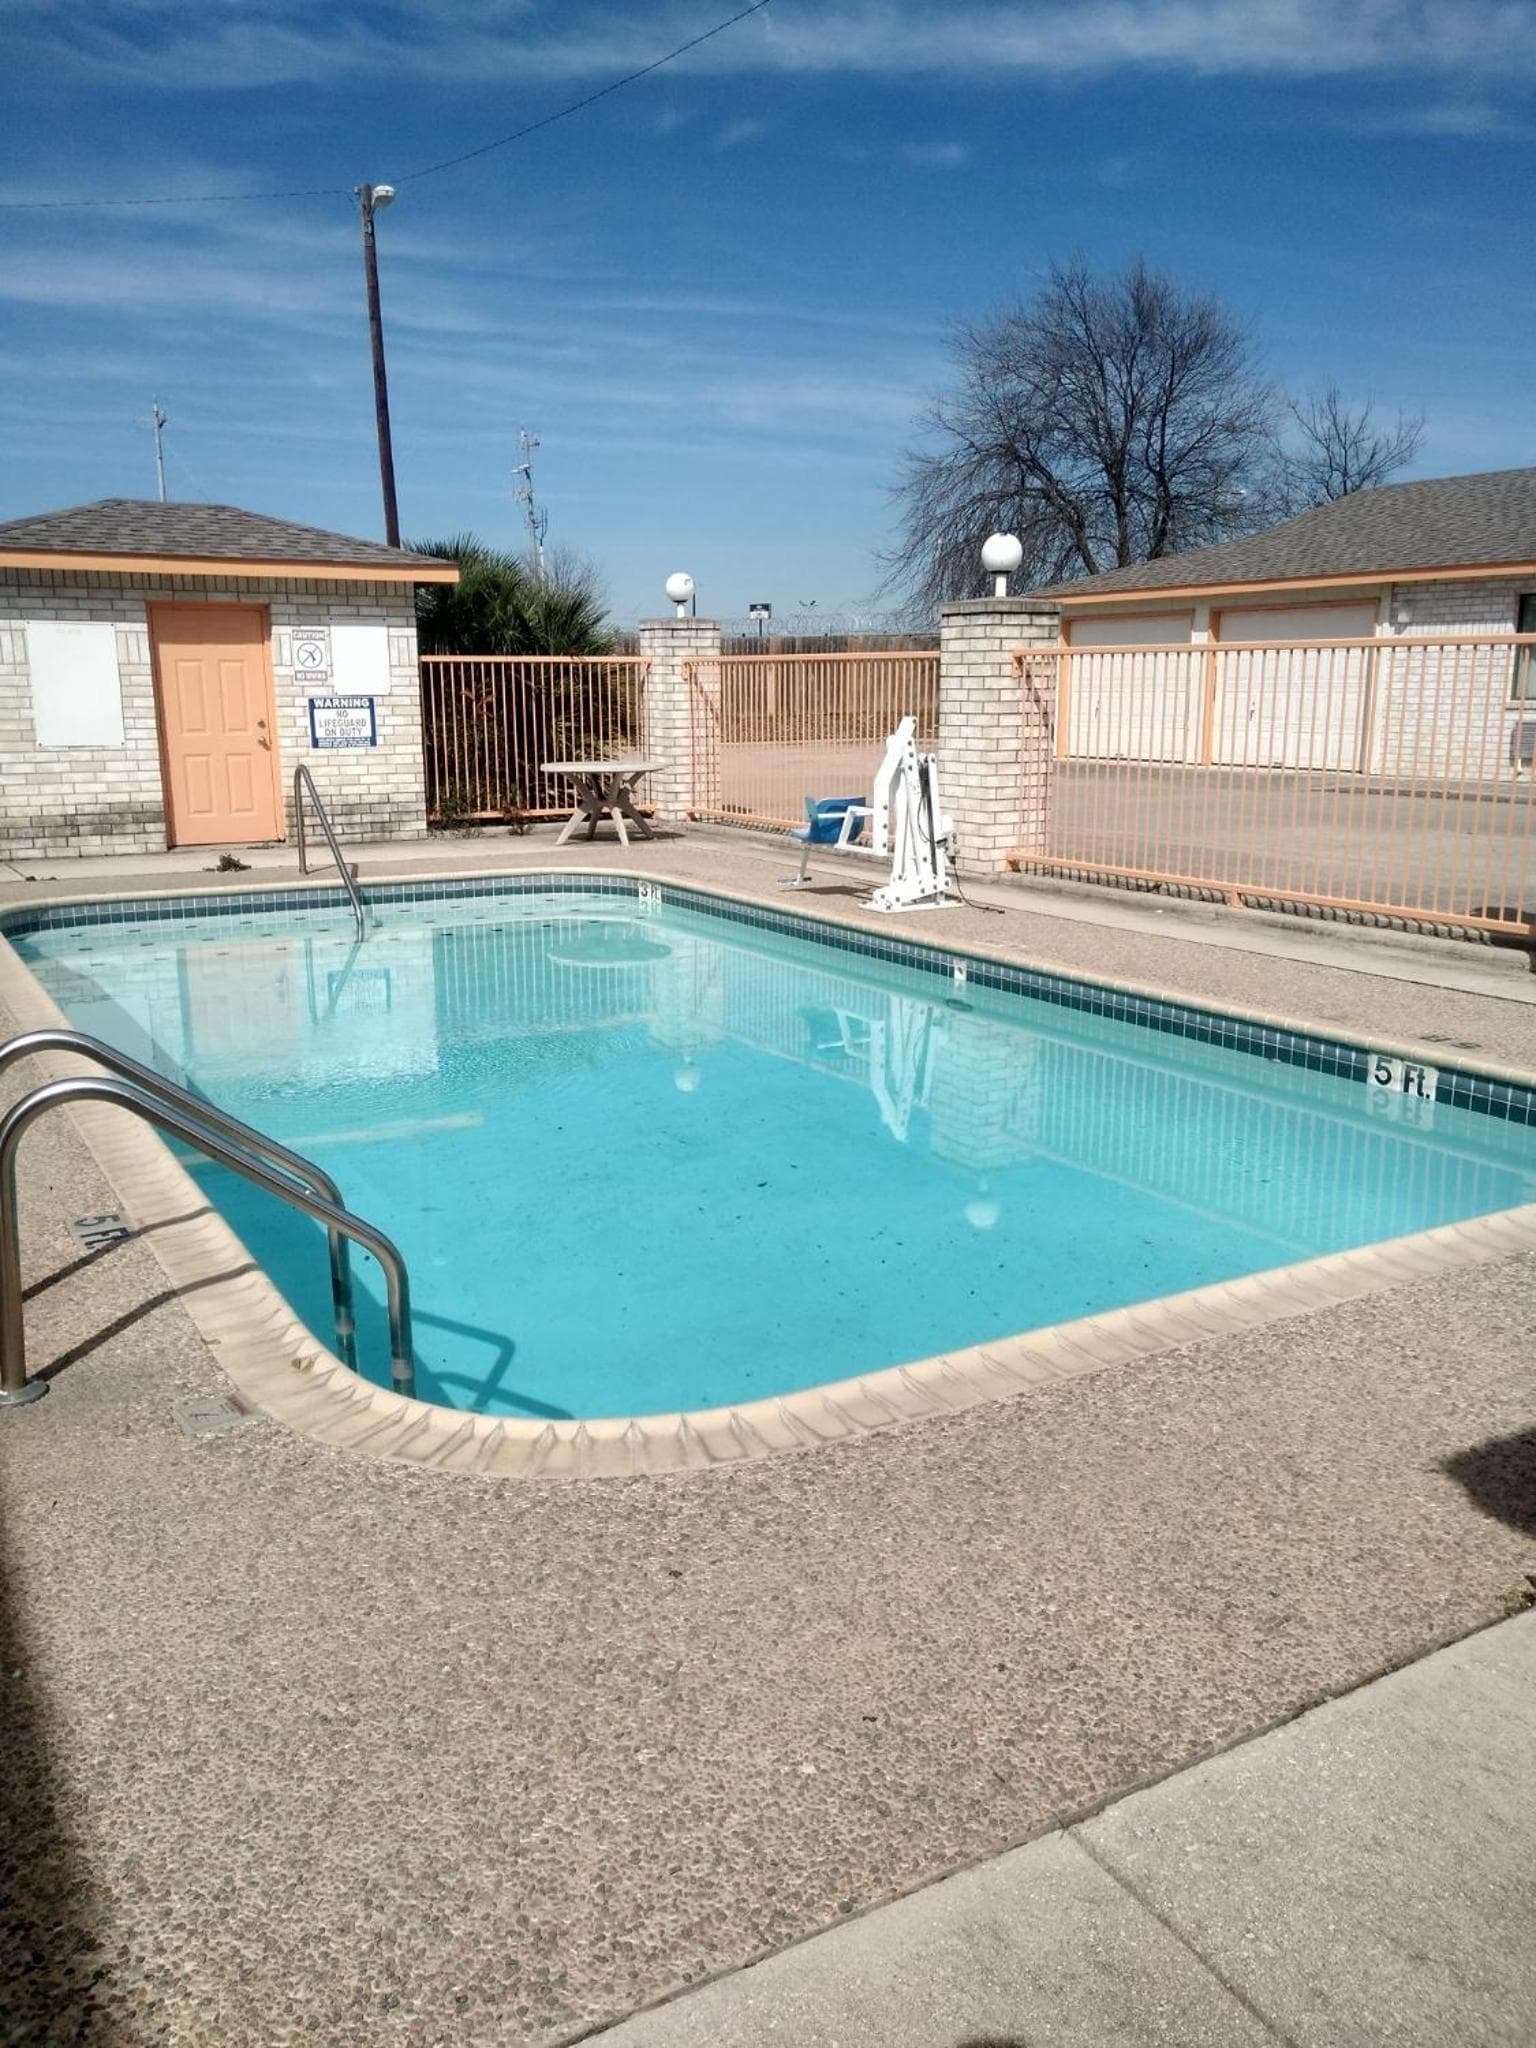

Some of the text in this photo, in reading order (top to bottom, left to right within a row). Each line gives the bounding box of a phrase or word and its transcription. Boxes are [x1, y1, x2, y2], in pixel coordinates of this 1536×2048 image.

[293, 631, 325, 640] CAUTION
[313, 698, 370, 707] WARNING
[336, 709, 349, 718] NO
[319, 719, 367, 727] LIFEGUARD
[324, 727, 362, 736] ON DUTY
[1374, 1056, 1430, 1099] 5 Ft.
